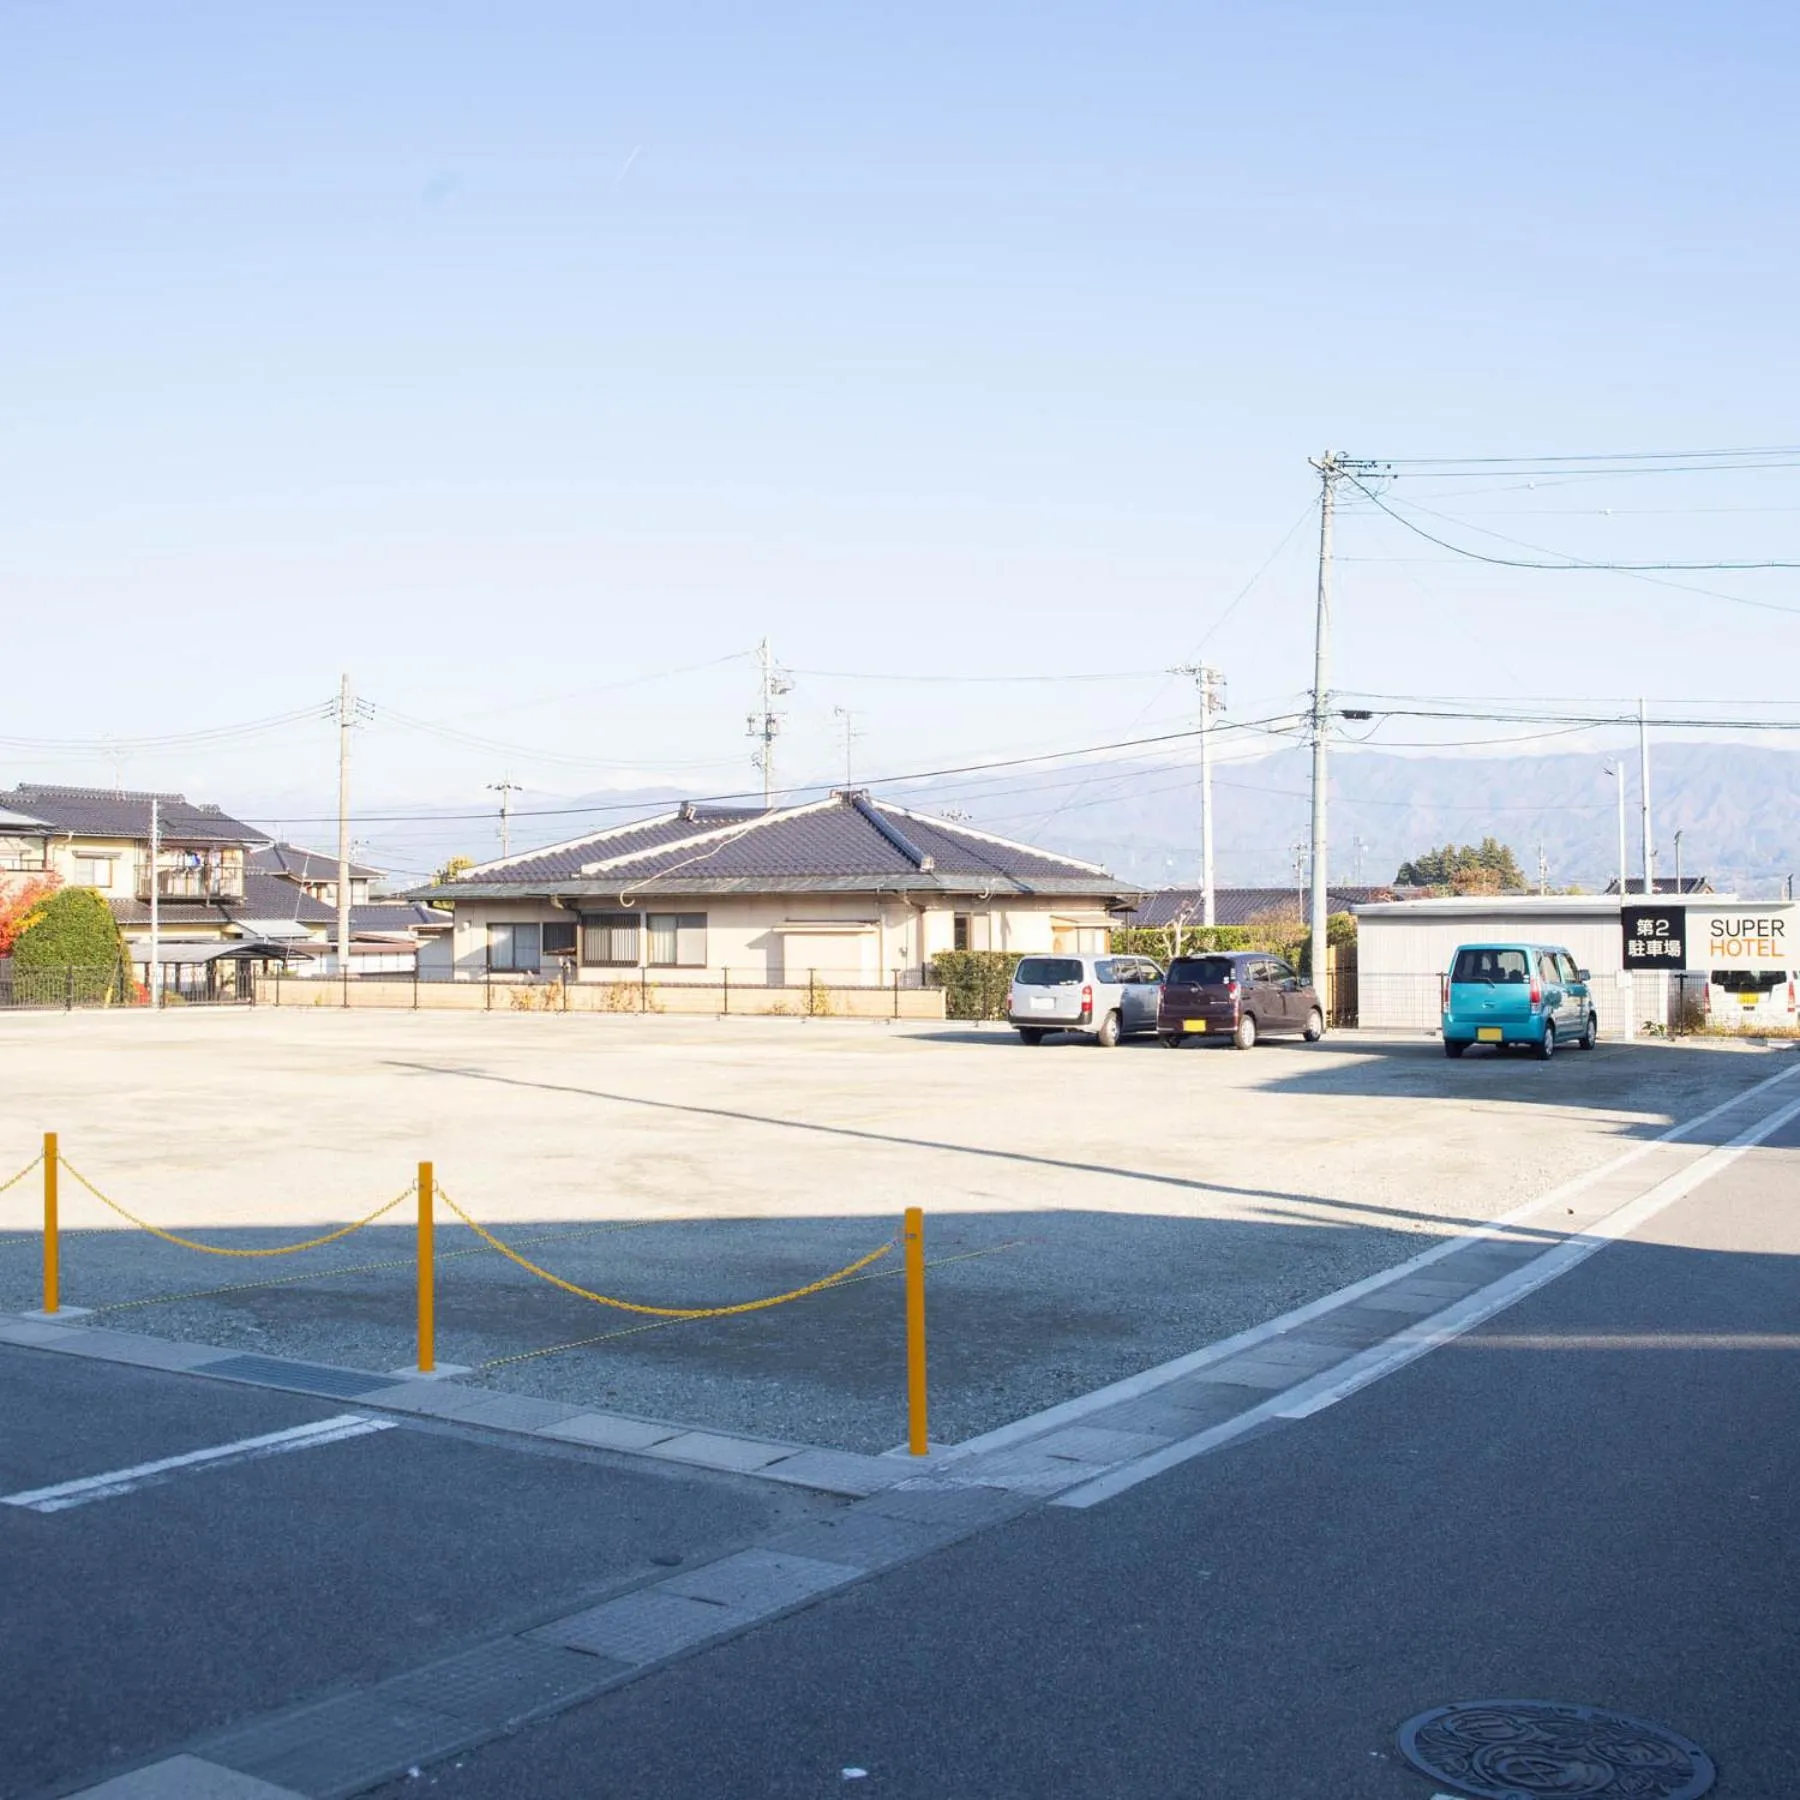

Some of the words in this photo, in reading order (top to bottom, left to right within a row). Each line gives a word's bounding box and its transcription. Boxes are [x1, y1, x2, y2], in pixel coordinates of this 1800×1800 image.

[1637, 919, 1670, 937] 第2
[1710, 919, 1785, 937] SUPER
[1628, 940, 1681, 958] 駐車場
[1710, 939, 1785, 957] HOTEL
